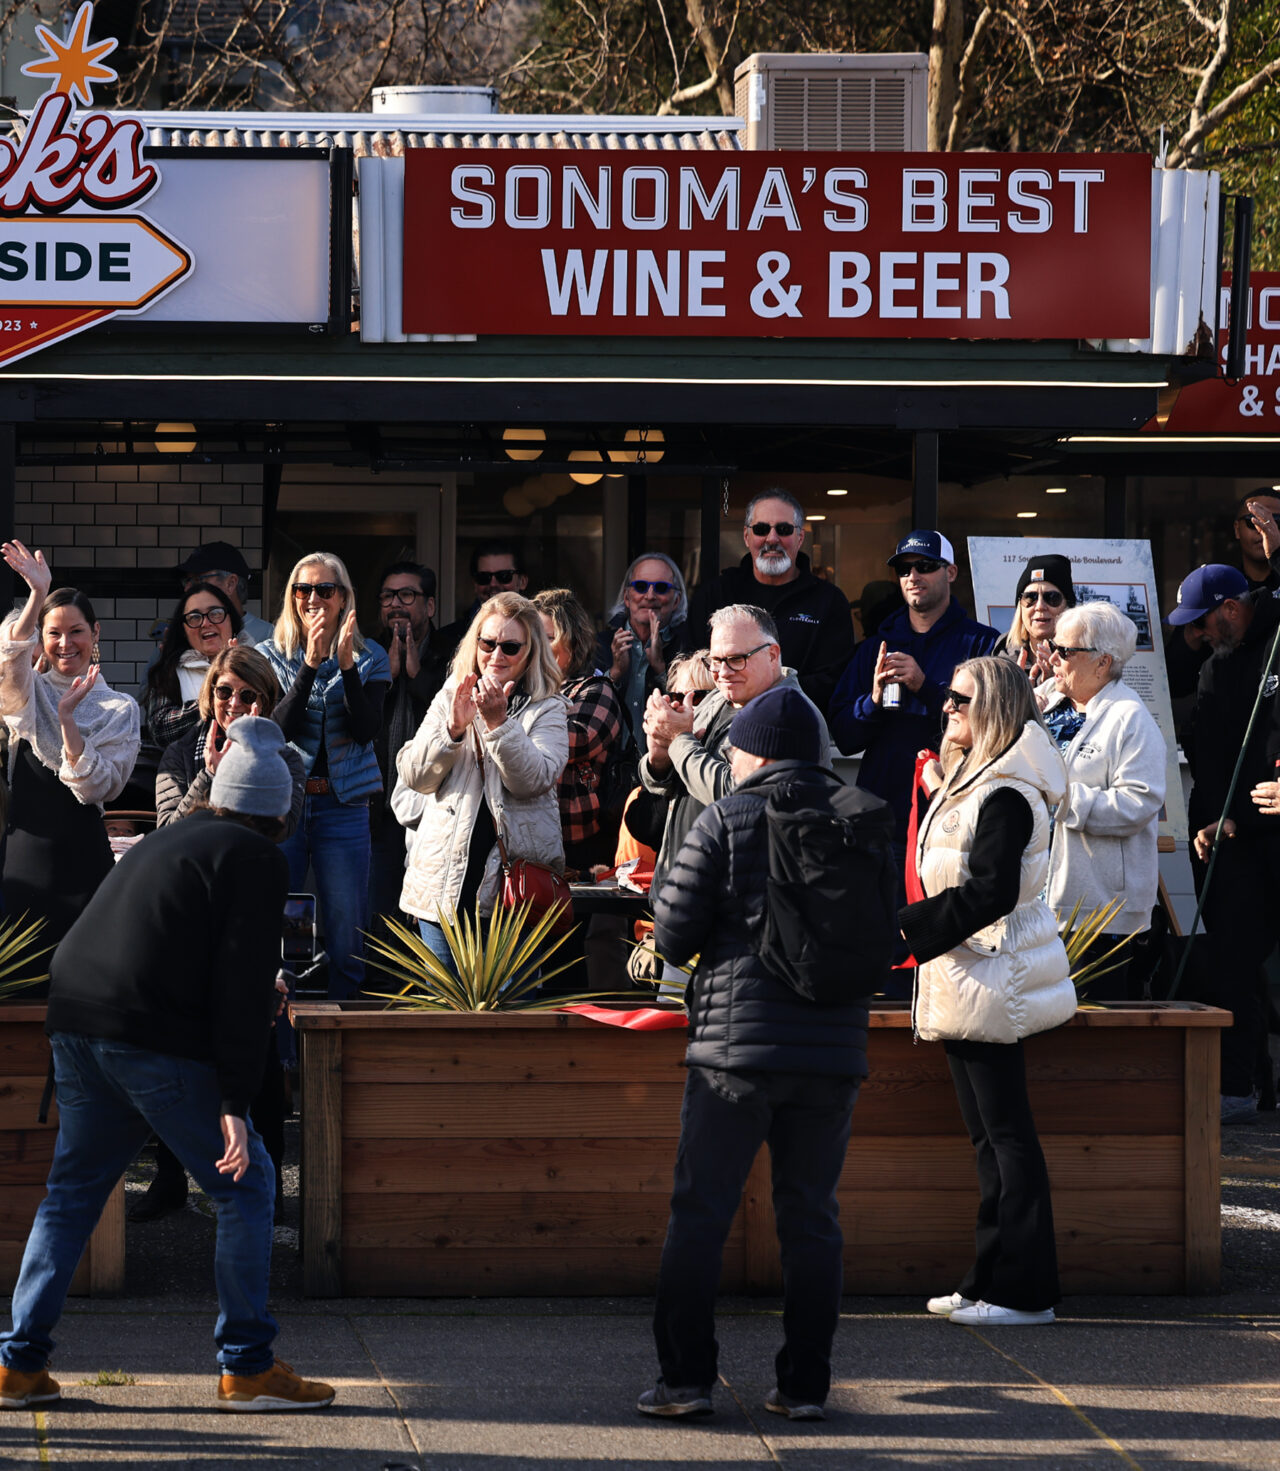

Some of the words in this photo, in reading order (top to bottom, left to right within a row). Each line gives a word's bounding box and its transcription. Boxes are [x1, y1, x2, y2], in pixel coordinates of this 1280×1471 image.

[450, 164, 869, 233] SONOMA'S
[901, 168, 1105, 234] BEST
[541, 249, 726, 318] WINE
[750, 251, 804, 319] &
[829, 252, 1012, 320] BEER
[1239, 385, 1264, 416] &
[1003, 555, 1016, 563] 117
[1083, 555, 1123, 565] Boulevard
